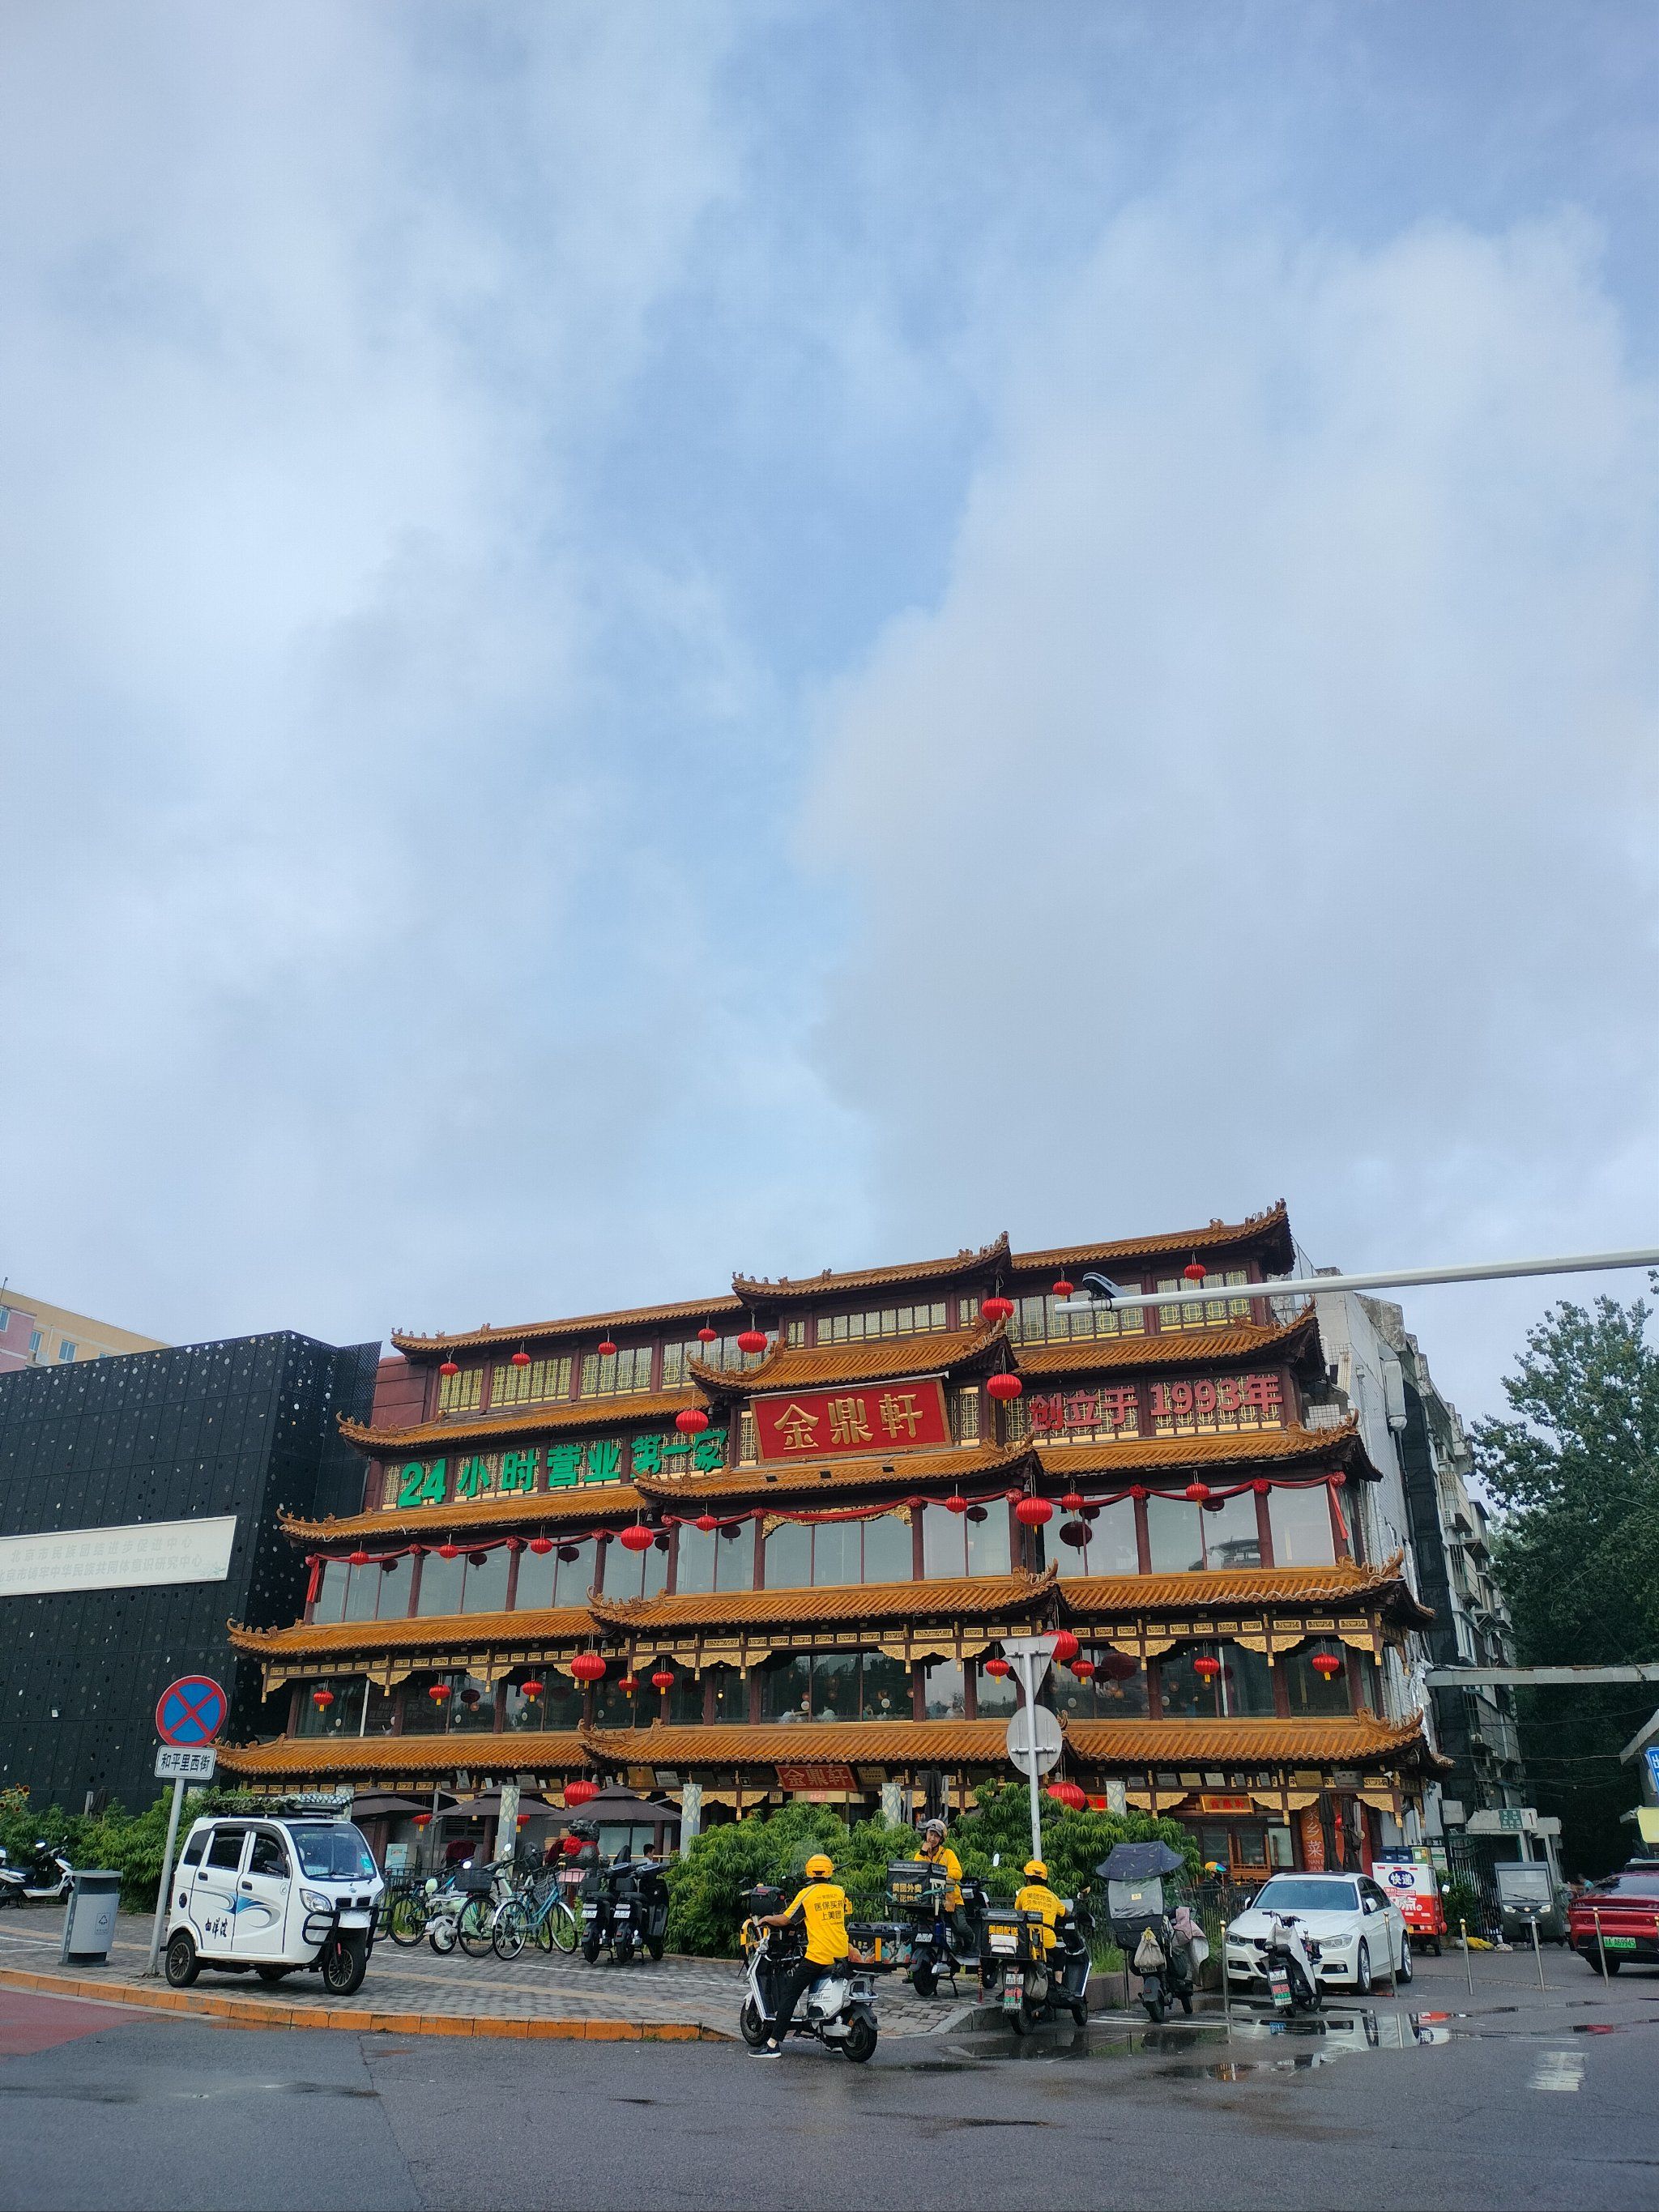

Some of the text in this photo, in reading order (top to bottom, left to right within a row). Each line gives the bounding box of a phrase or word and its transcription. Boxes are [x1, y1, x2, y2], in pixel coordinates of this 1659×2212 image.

[1028, 1374, 1283, 1432] 创立于1993年
[774, 1393, 924, 1450] 金鼎軒
[397, 1427, 727, 1507] 24小时营业第一家
[161, 1753, 211, 1772] 和平里西街
[1303, 1805, 1324, 1858] 家乡菜
[892, 1882, 922, 1894] 美团外卖
[1390, 1873, 1413, 1886] 快递
[813, 1899, 843, 1912] 医保买药
[988, 1924, 1018, 1937] 美团配送
